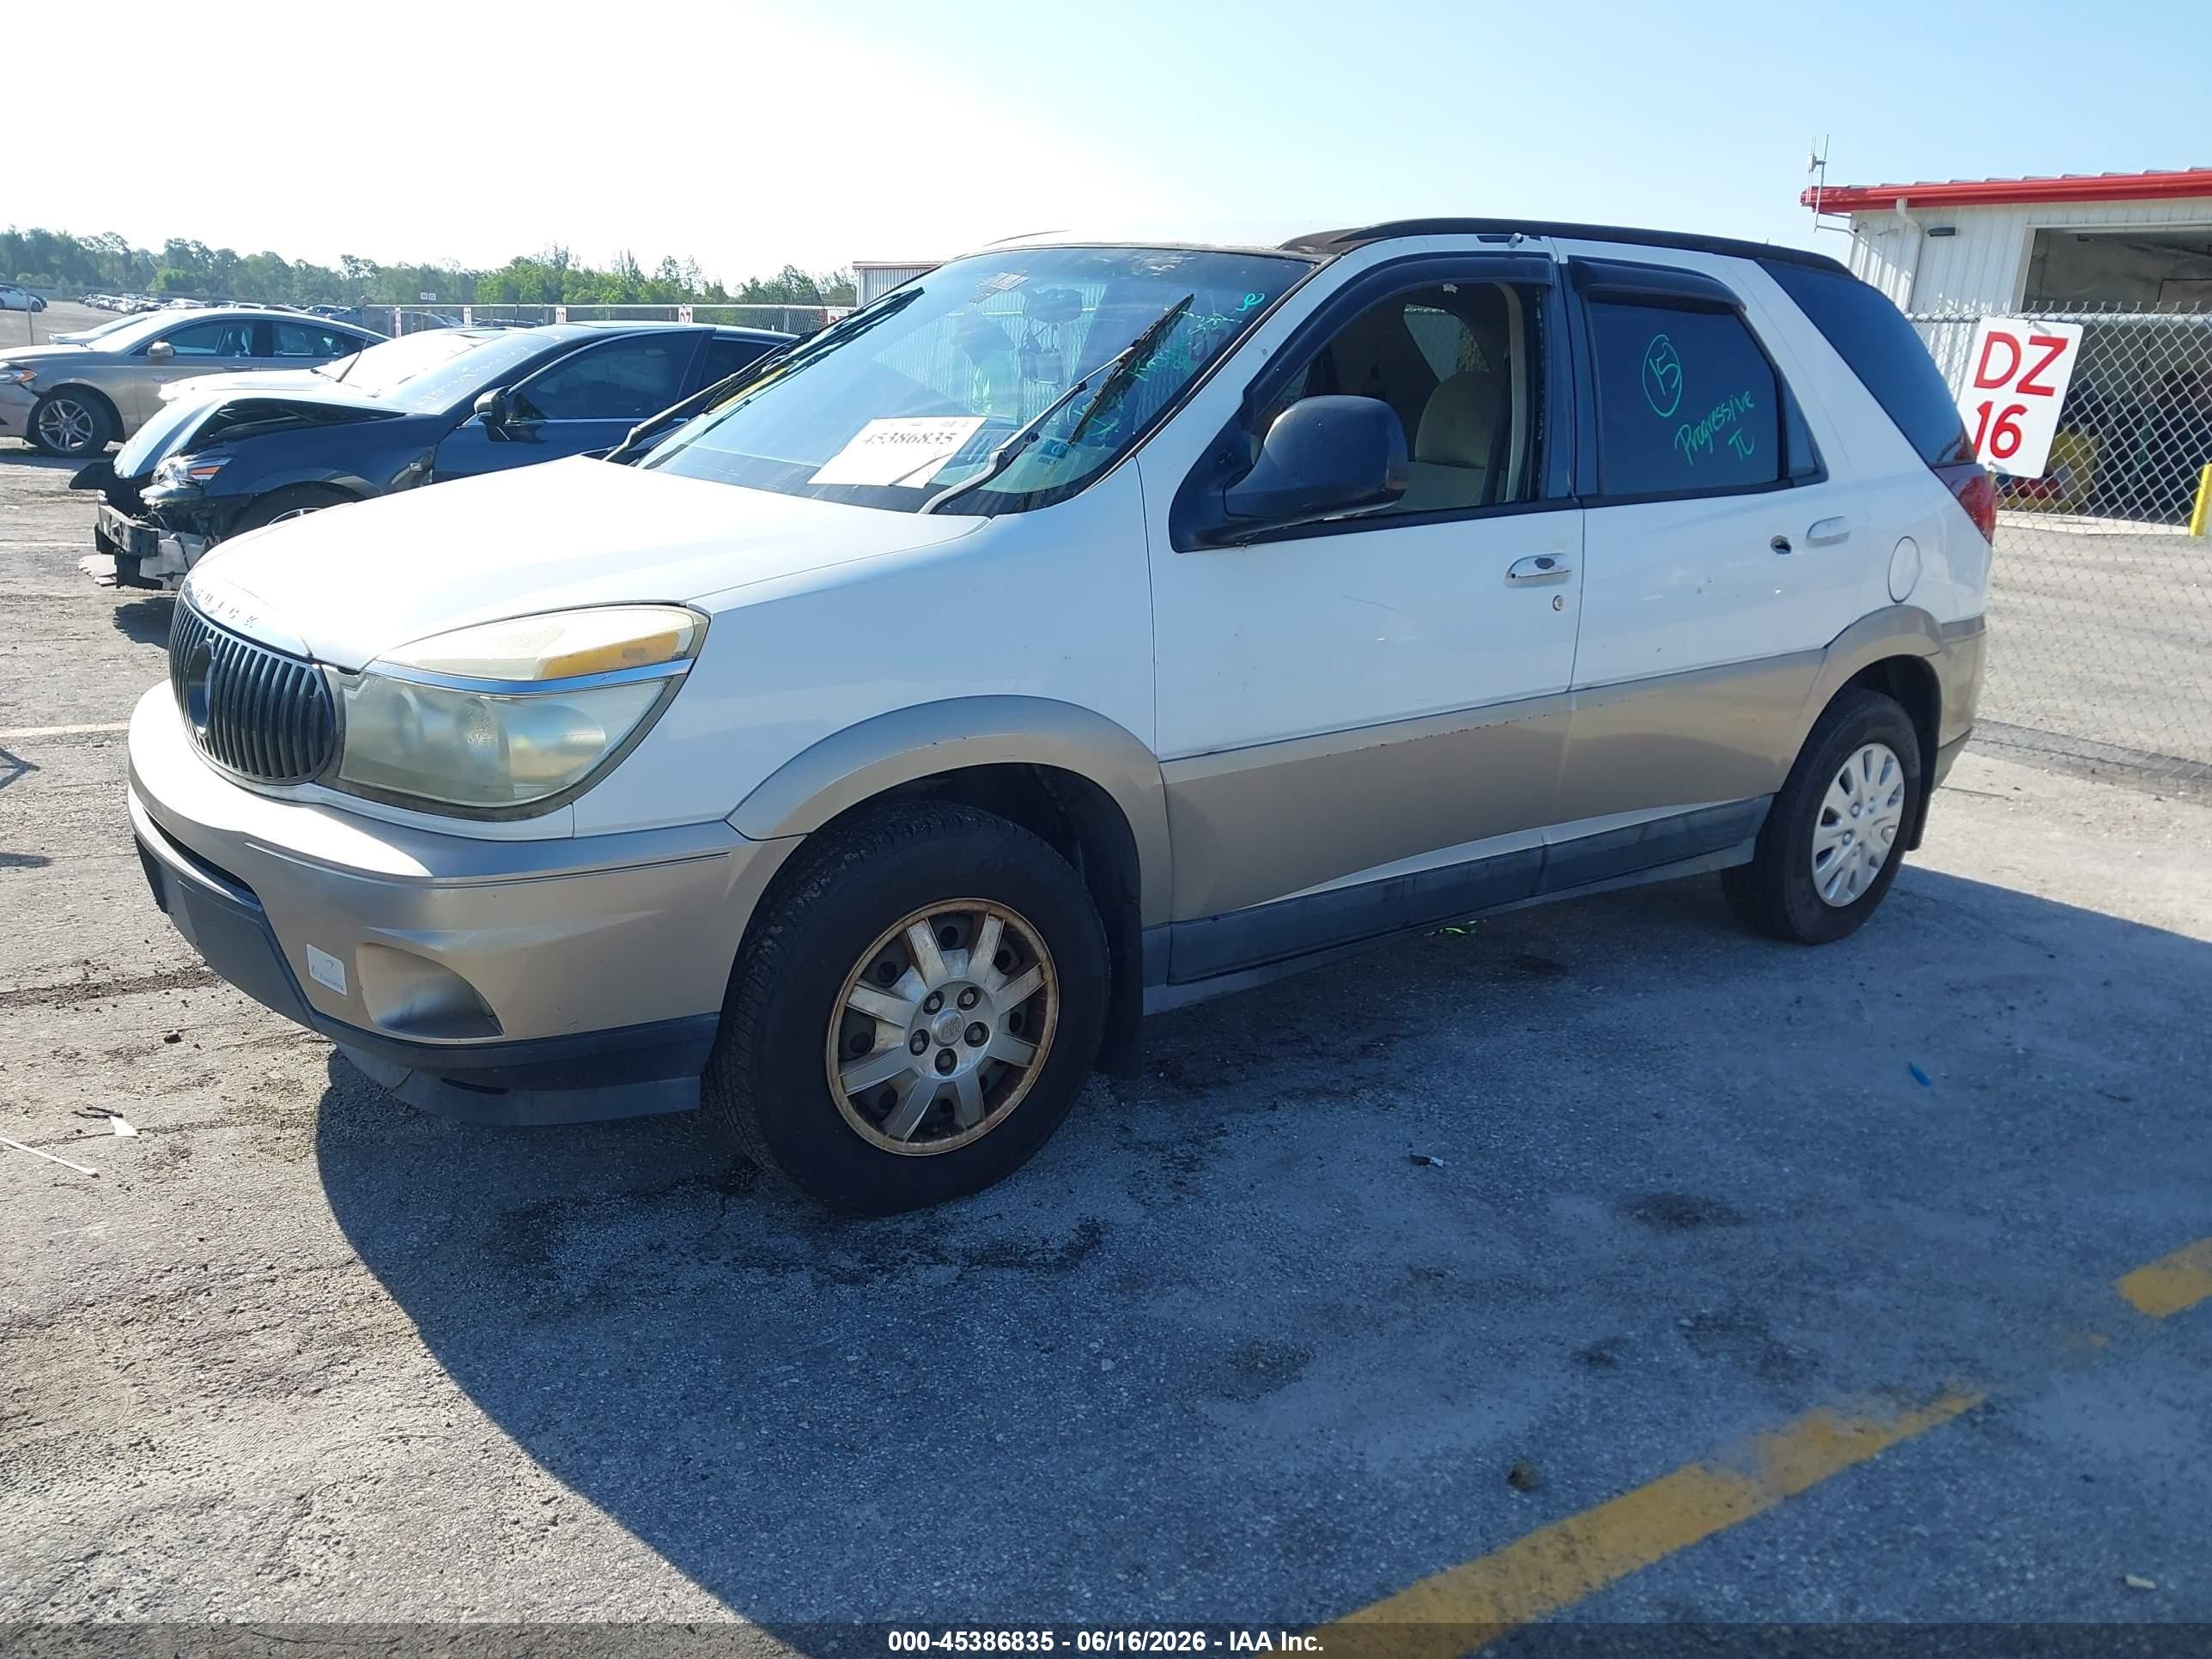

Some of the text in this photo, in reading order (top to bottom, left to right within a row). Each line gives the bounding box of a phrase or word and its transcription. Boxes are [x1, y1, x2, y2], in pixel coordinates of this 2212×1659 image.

[1648, 349, 1682, 397] 15
[1973, 330, 2069, 398] DZ
[861, 432, 957, 445] 45386835
[1674, 391, 1754, 465] Progressive
[1972, 400, 2029, 459] 16
